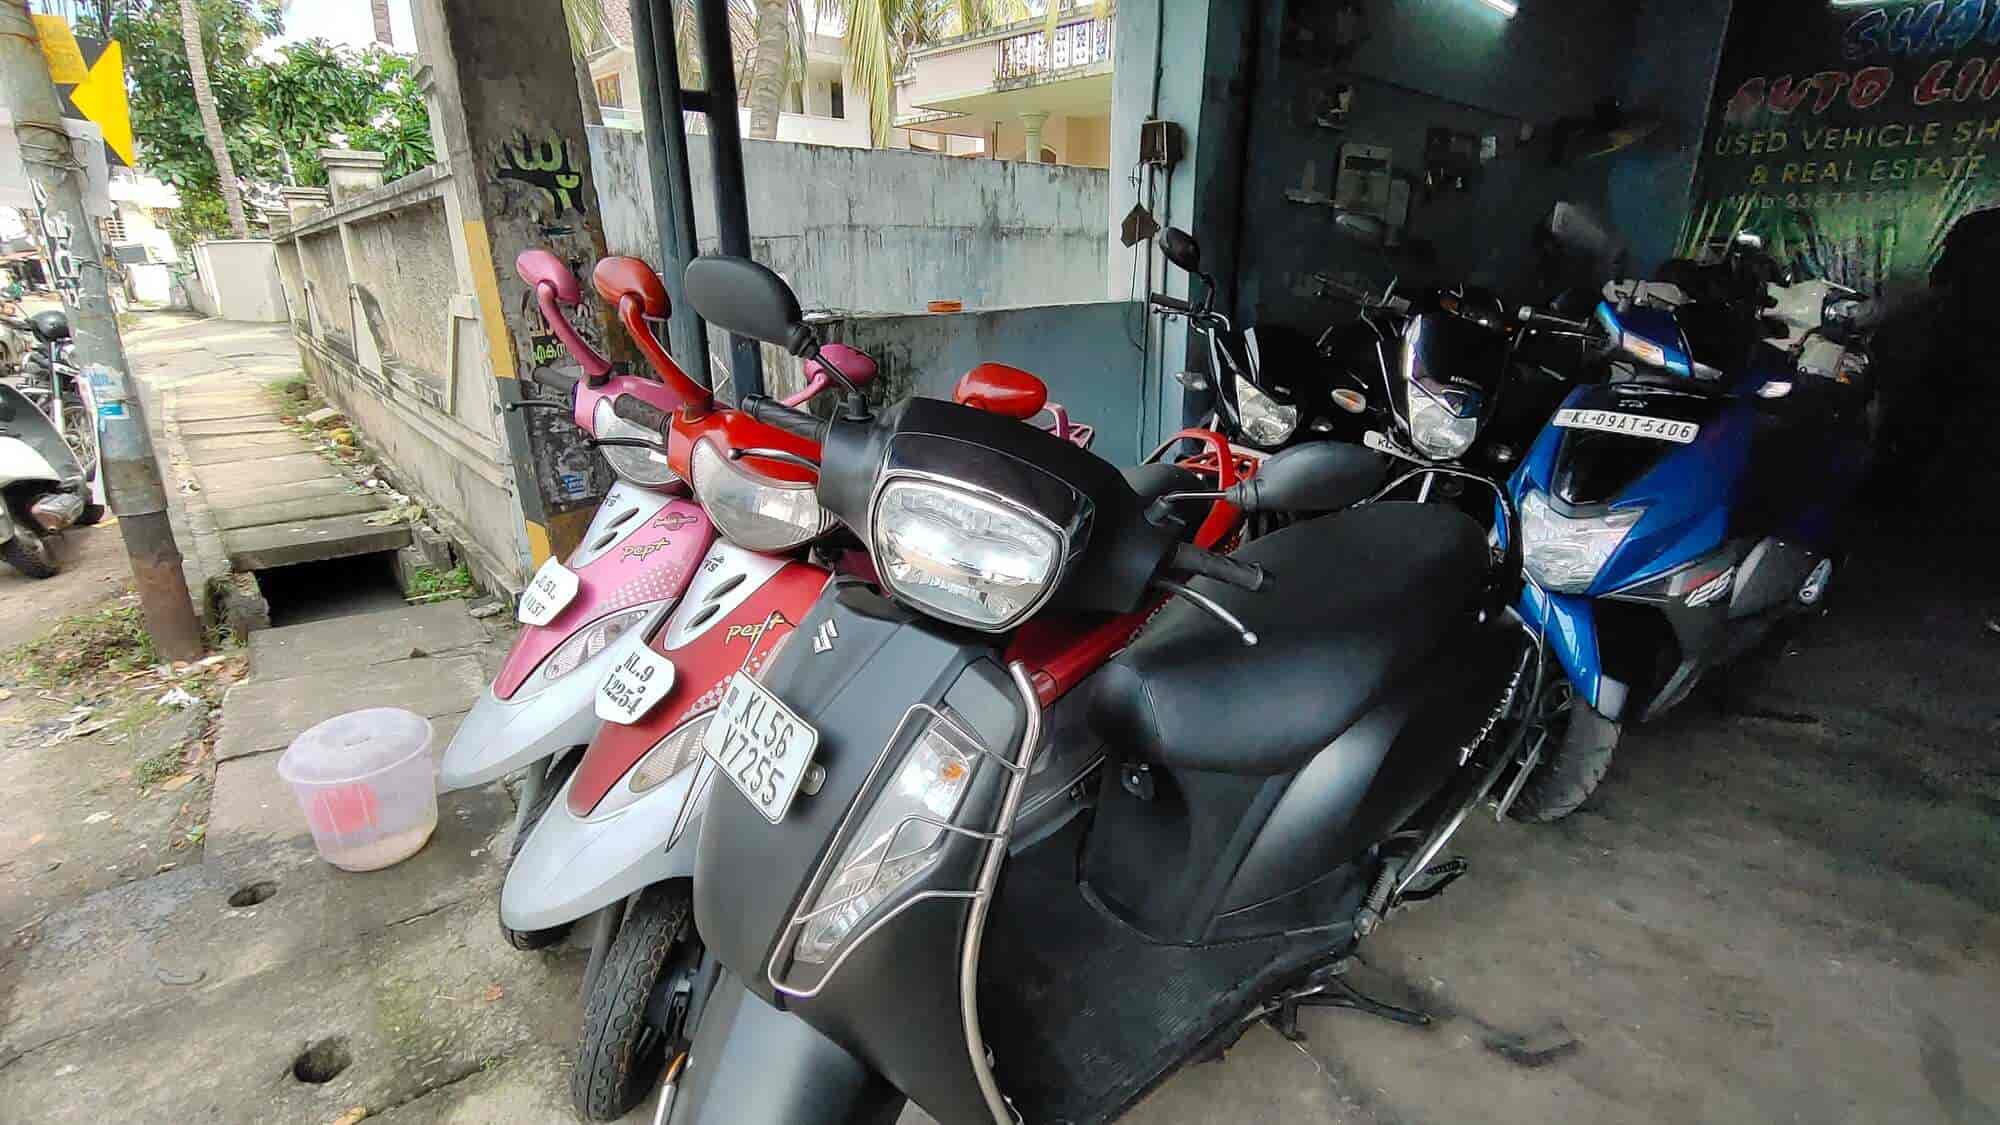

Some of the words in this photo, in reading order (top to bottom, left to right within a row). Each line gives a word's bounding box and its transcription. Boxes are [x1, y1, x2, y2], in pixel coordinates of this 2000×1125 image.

[1726, 66, 1894, 117] AUTO
[1714, 129, 1788, 156] USED
[1801, 121, 1941, 151] VEHICLE
[1750, 164, 1768, 185] &
[1782, 160, 1856, 184] REAL
[1870, 154, 1985, 182] ESTATE
[740, 691, 794, 760] KL56
[718, 723, 785, 806] V7255
